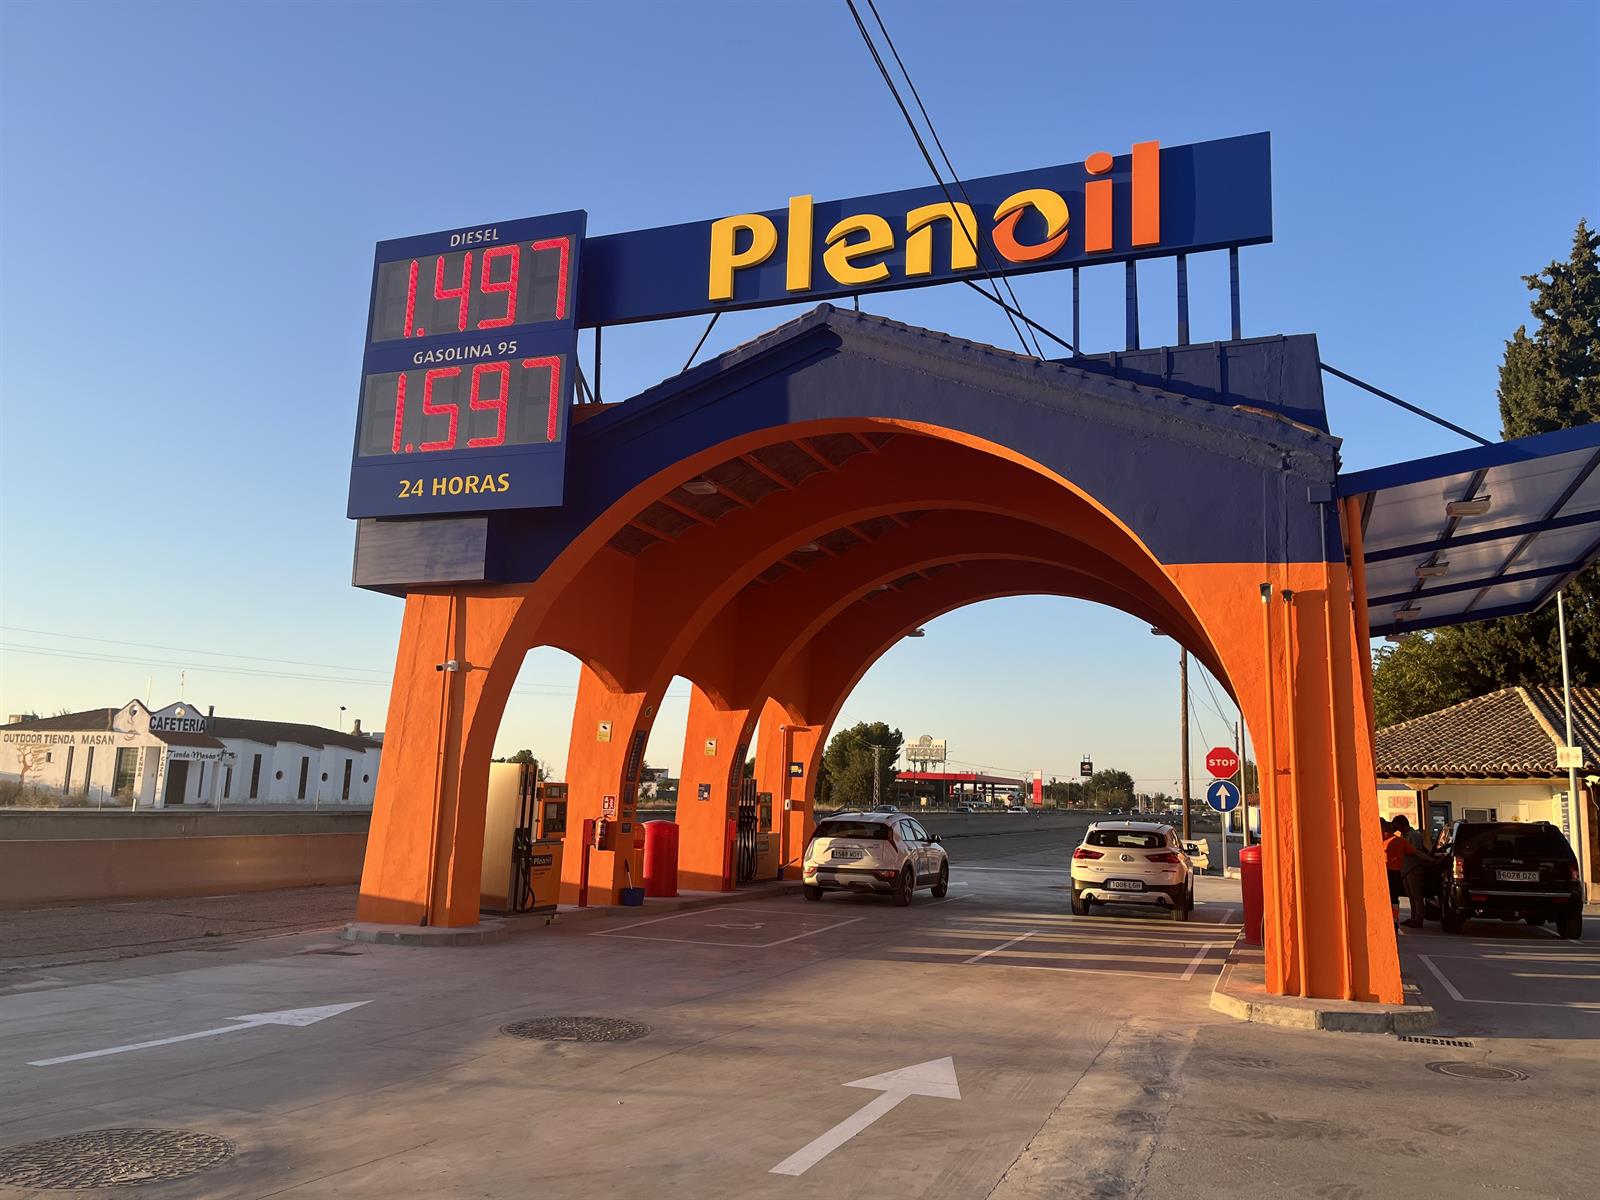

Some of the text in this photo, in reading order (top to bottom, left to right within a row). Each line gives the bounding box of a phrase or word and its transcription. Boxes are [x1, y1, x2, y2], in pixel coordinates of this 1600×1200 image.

[450, 228, 500, 247] DIESEL
[403, 236, 570, 338] 1.497
[413, 340, 518, 365] GASOLINA 95
[391, 355, 561, 454] 1.597
[397, 472, 511, 498] 24 HORAS
[149, 716, 206, 732] CAFETERIA
[4, 733, 115, 745] OUTDOOR TIENDA MASAN
[1209, 758, 1236, 767] STOP
